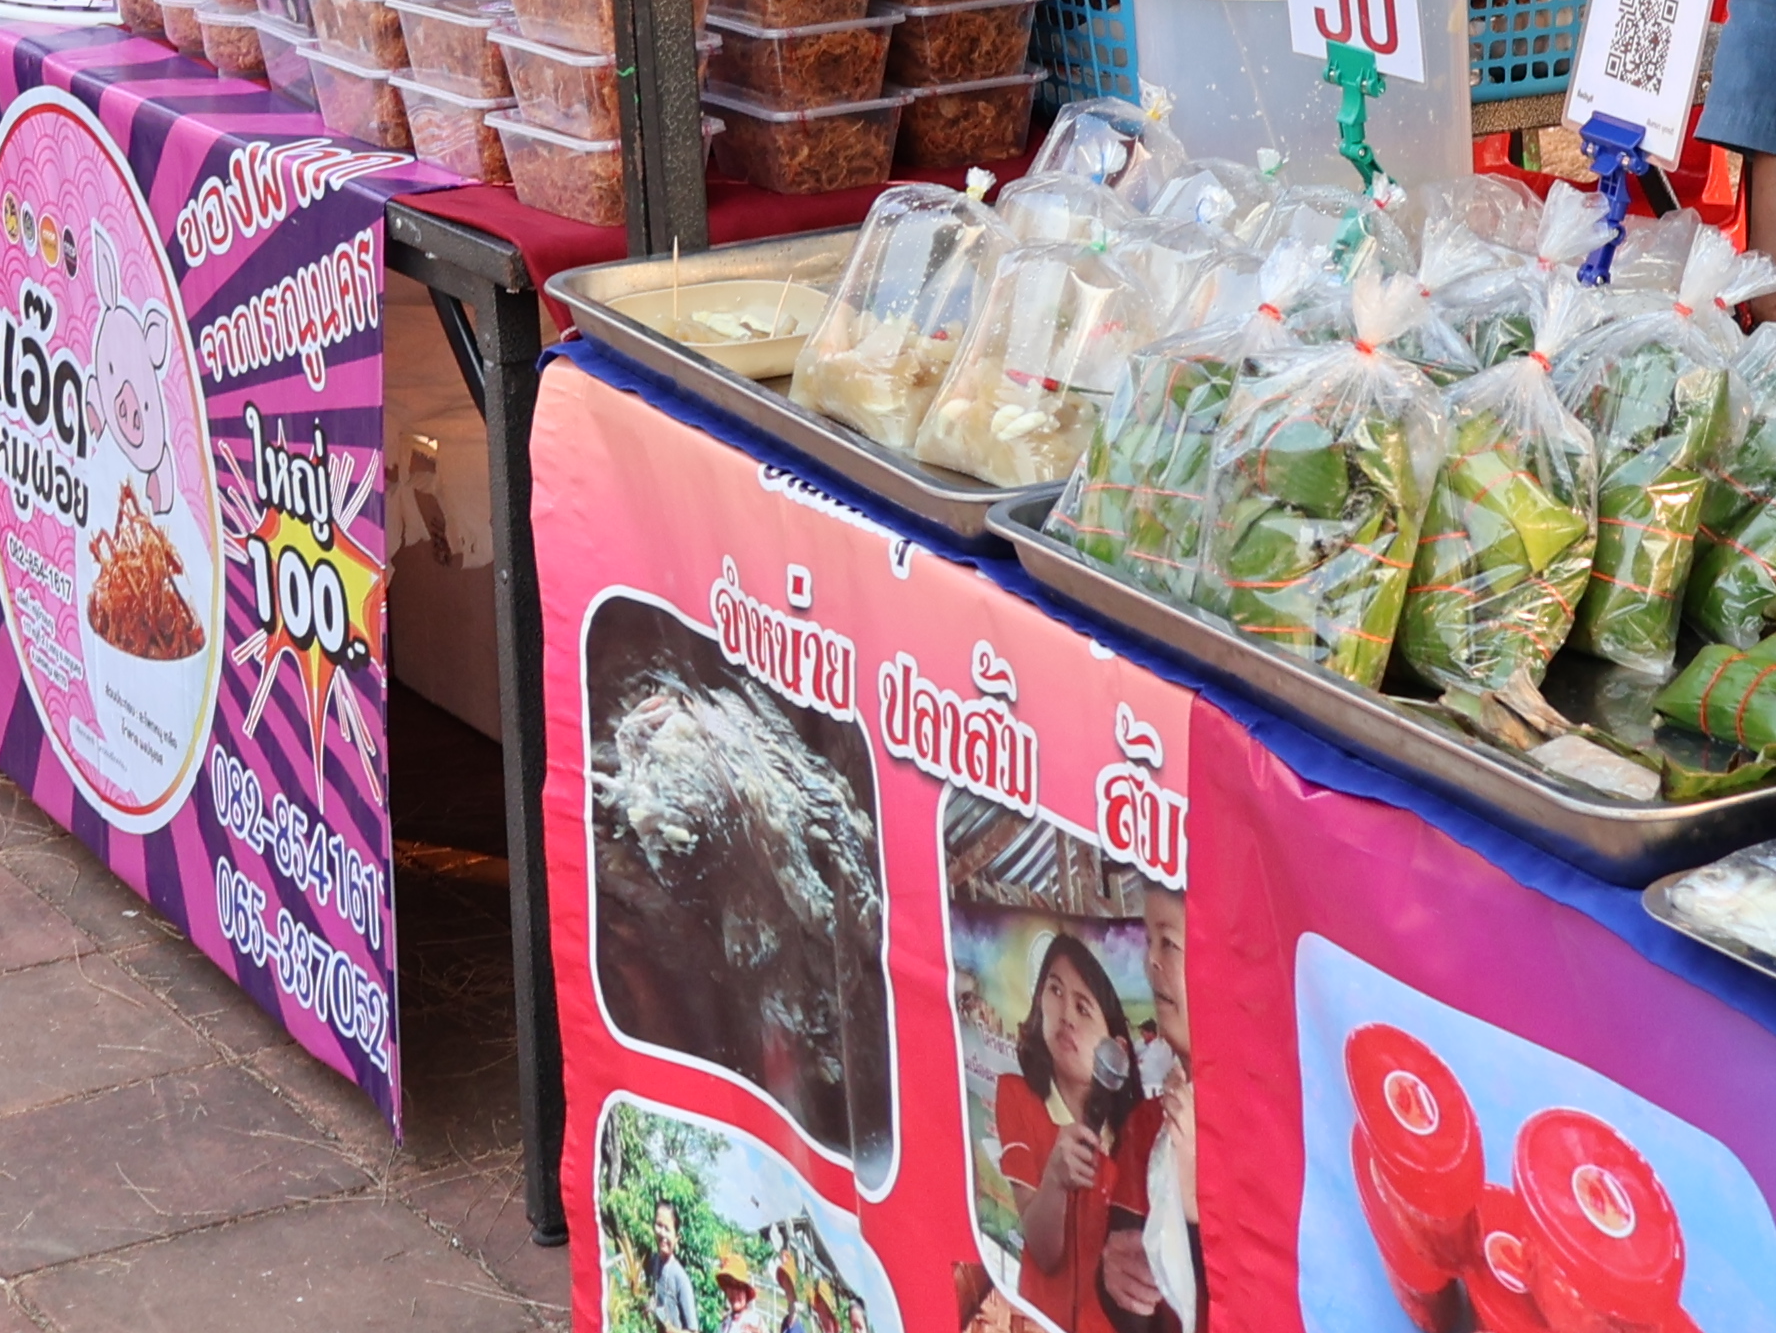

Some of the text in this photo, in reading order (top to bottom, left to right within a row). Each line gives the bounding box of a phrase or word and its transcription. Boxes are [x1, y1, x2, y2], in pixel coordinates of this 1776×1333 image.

[177, 138, 415, 267] ของฝาก
[200, 228, 379, 391] จากเรณูนคร
[244, 405, 333, 544] ใหญ่
[248, 536, 367, 659] 100.-
[713, 560, 1185, 880] จำหน่าย ปลาส้ม ส้ม
